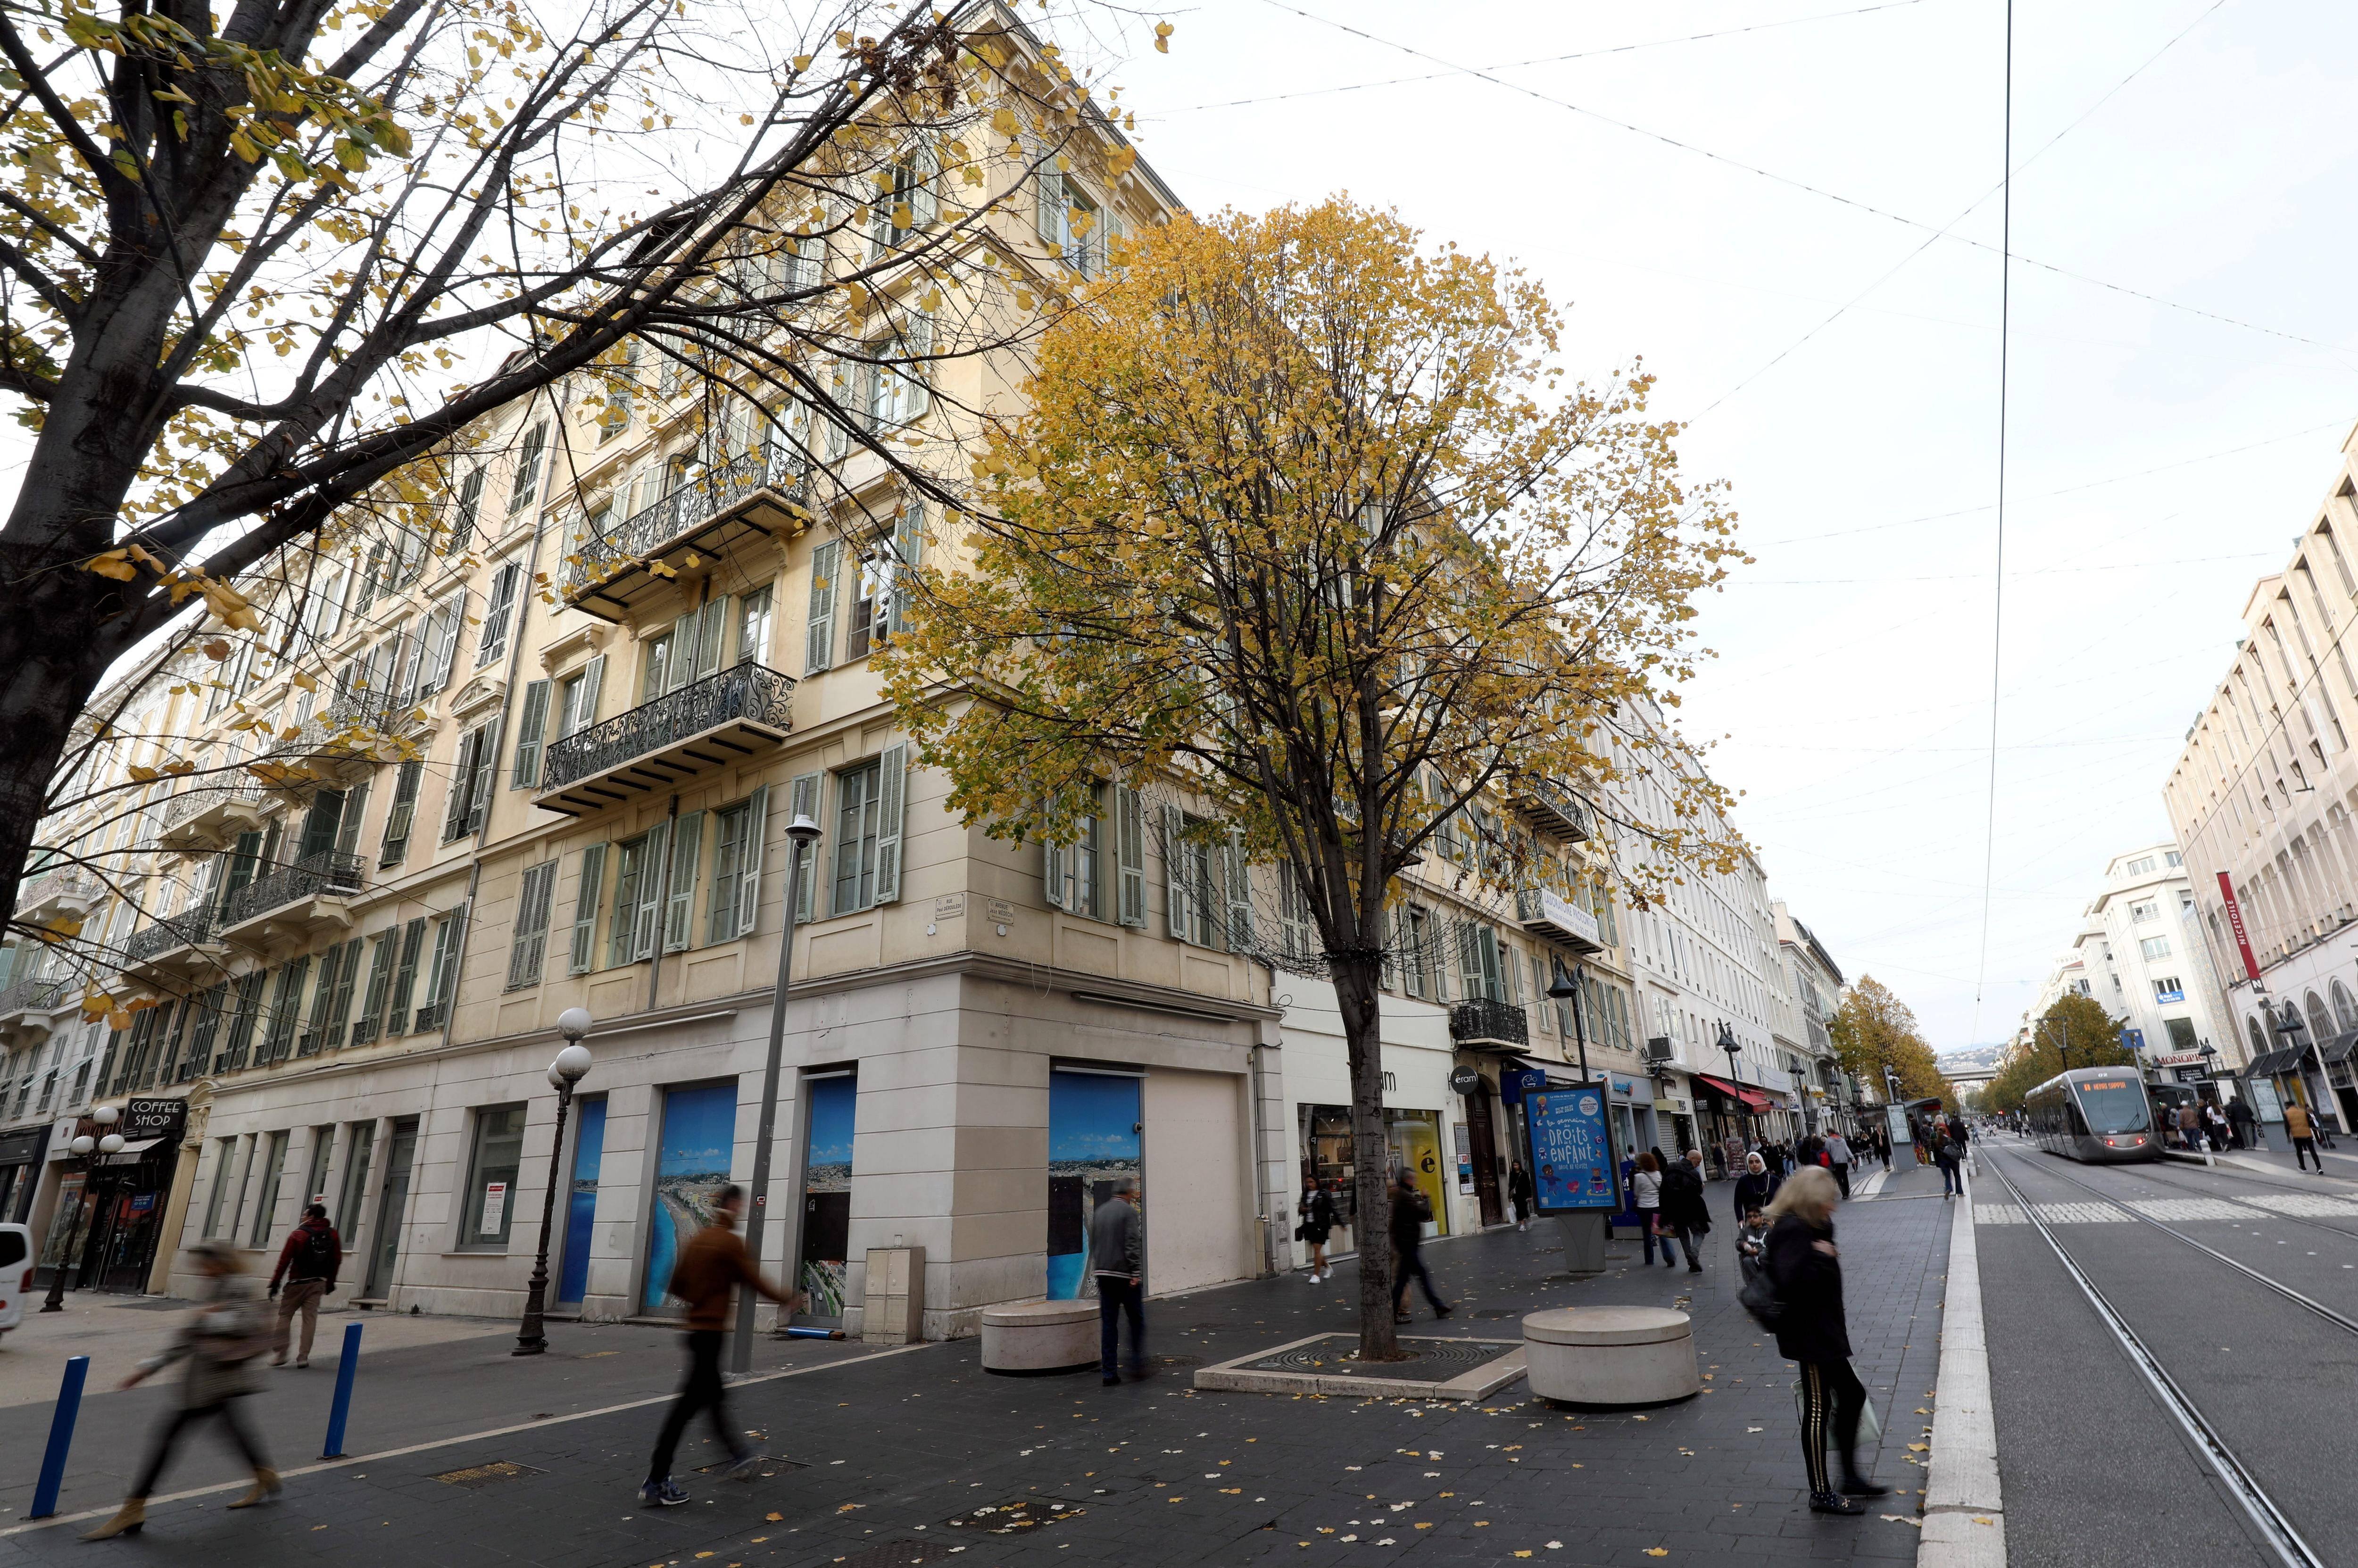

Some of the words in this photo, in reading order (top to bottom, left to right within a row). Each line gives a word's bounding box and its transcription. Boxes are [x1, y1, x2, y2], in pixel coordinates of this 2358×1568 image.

[995, 902, 1008, 910] AVENUE
[2227, 899, 2246, 945] NICETOILE
[2156, 1053, 2203, 1065] MONOPR
[1455, 1074, 1477, 1084] éram
[132, 1101, 181, 1113] COFFEE
[135, 1115, 170, 1126] SHOP
[1421, 1149, 1436, 1173] é
